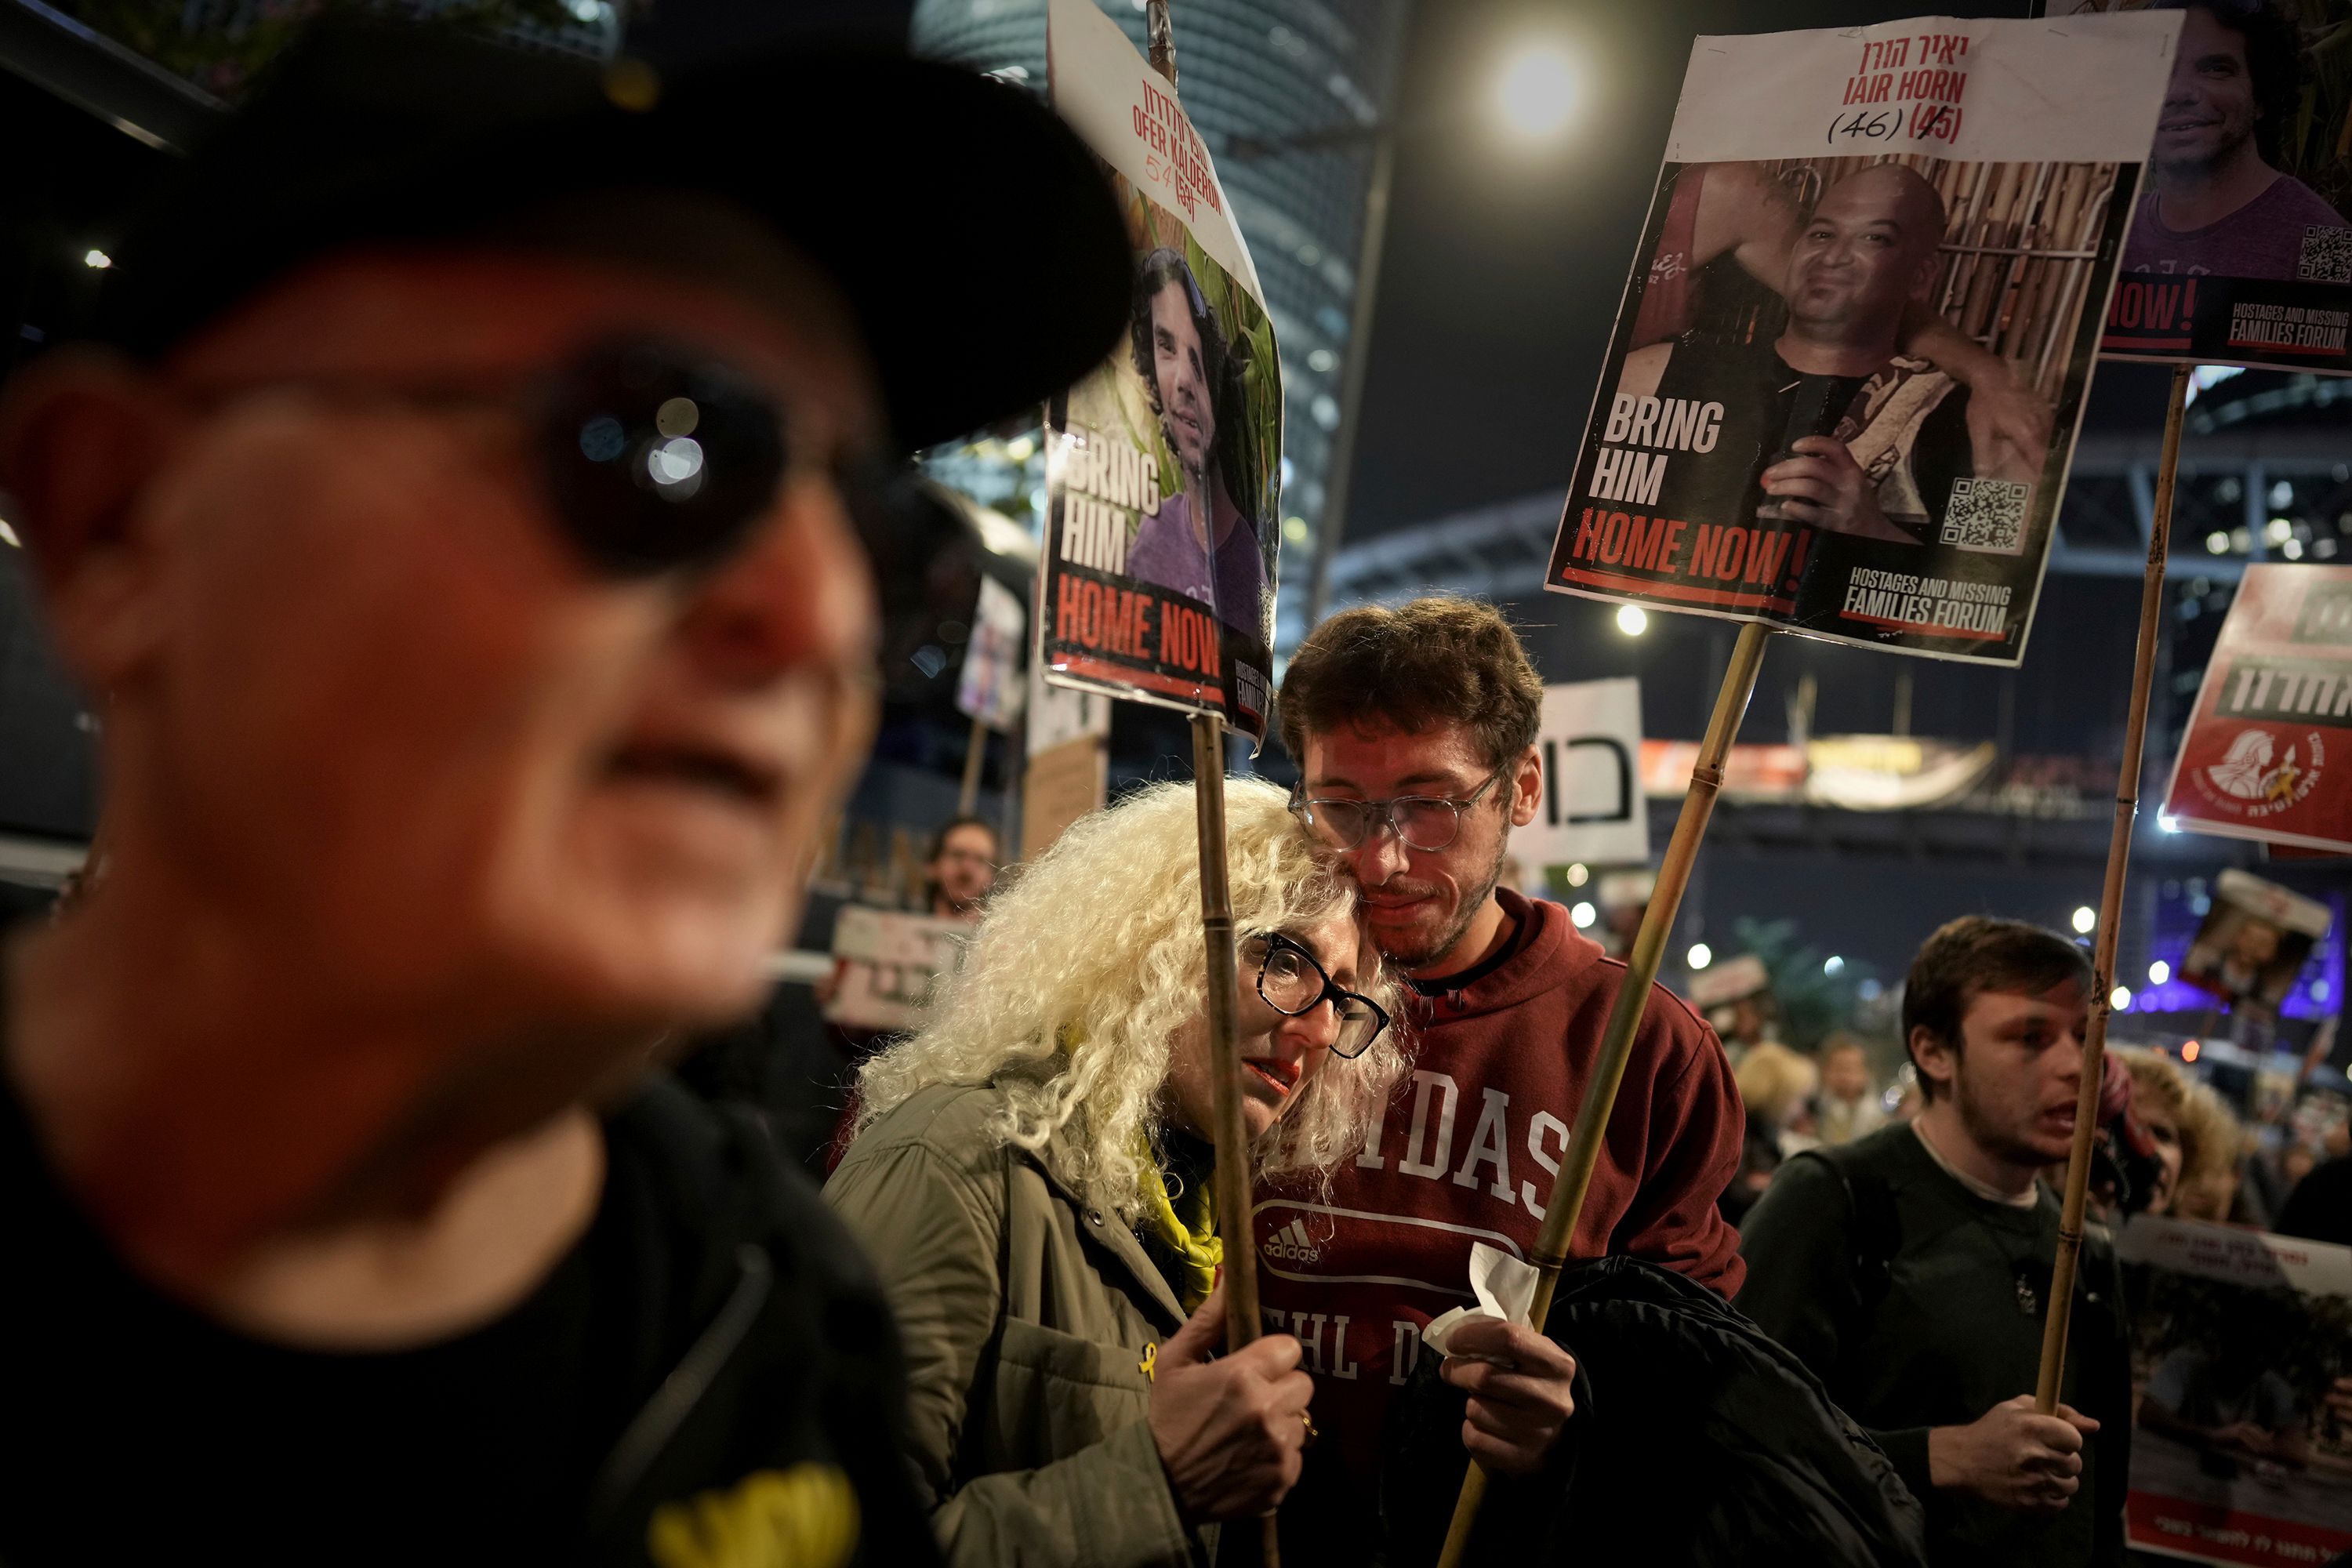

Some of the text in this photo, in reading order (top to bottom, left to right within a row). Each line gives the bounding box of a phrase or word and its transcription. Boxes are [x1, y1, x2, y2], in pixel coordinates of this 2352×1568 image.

[1859, 34, 1969, 74] יאיר הורן
[1842, 69, 1967, 105] IAIR HORN
[1828, 108, 1903, 144] (46)
[1908, 103, 1962, 144] (45)
[1133, 104, 1221, 216] OFER KALDERON
[1145, 154, 1173, 188] 54
[2230, 318, 2347, 350] FAMILIES FORUM
[2234, 303, 2350, 328] HOSTAGES AND MISSING
[1603, 391, 1725, 454] BRING
[1588, 447, 1668, 506] HIM
[1060, 495, 1127, 576] HIM
[1572, 507, 1811, 592] HOME NOW!
[1849, 566, 2013, 606] HOSTAGES AND MISSING
[1057, 572, 1221, 679] HOME NOW
[1843, 586, 2009, 634] FAMILIES FORUM
[1264, 1243, 1319, 1263] adidas
